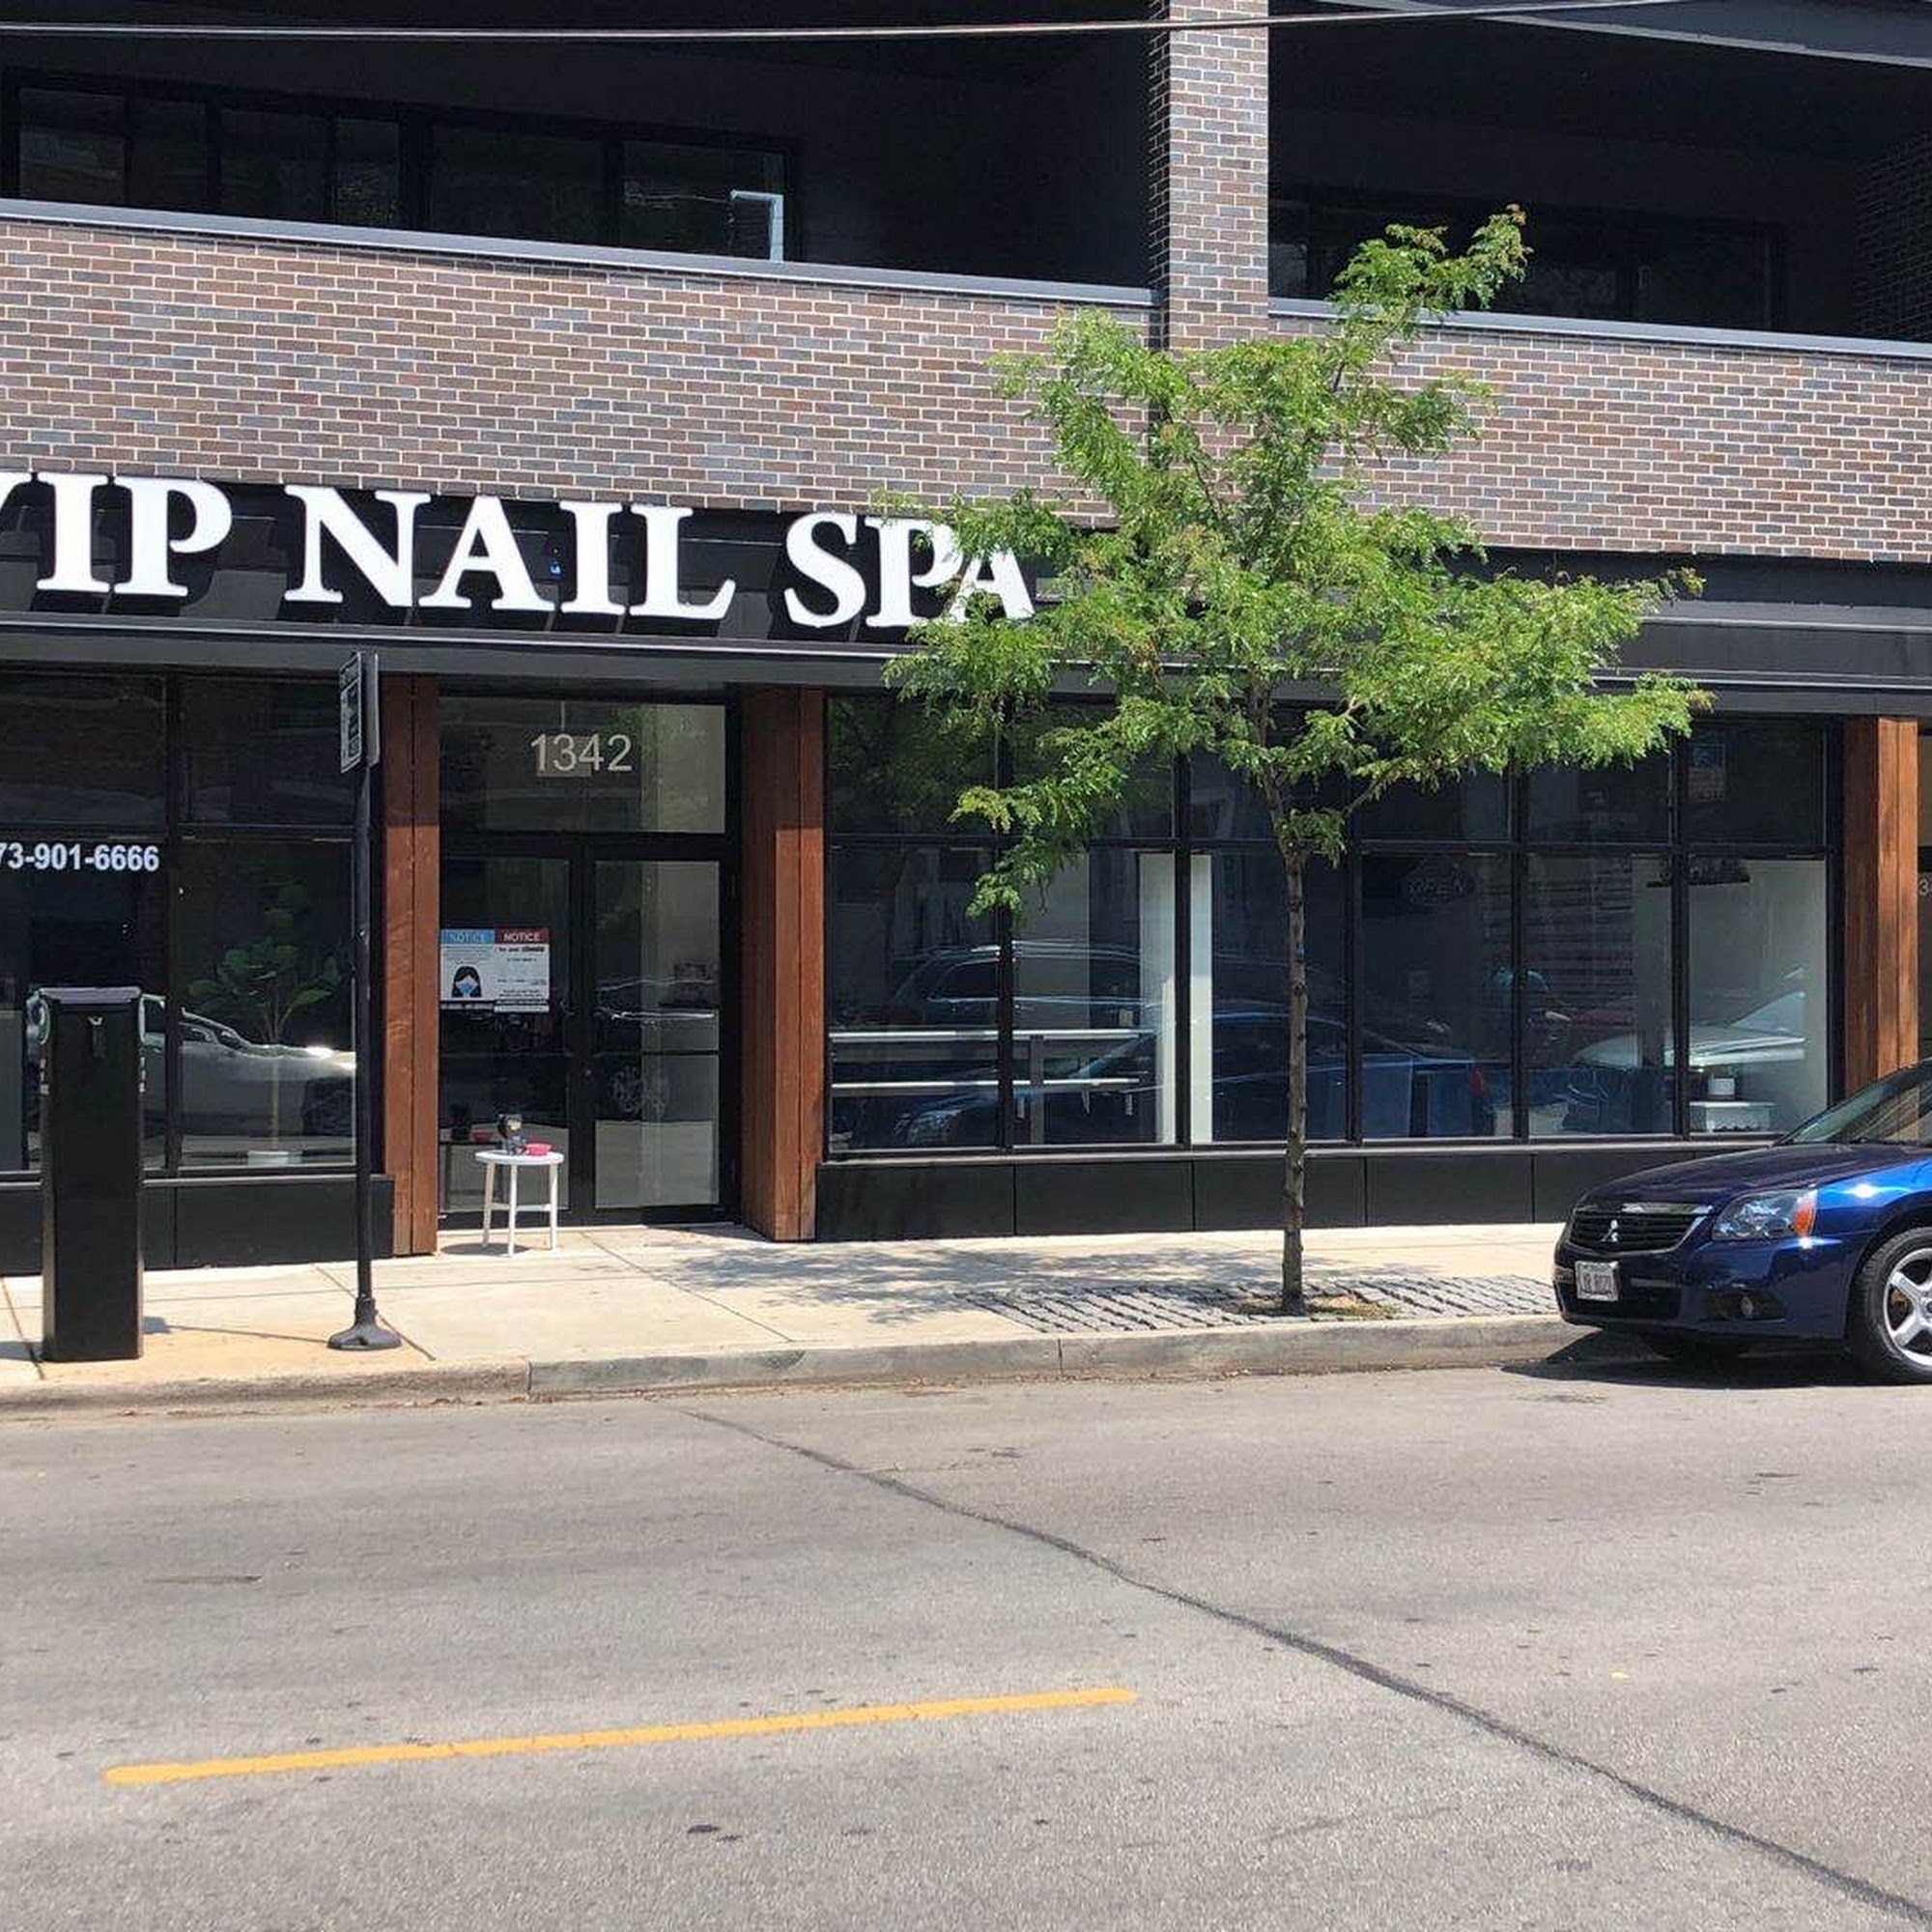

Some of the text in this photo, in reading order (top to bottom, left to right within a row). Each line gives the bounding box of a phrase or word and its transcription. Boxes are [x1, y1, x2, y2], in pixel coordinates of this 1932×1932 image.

[285, 484, 736, 619] NAIL
[784, 511, 1036, 628] SPA
[530, 733, 633, 772] 1342
[449, 931, 487, 943] NOTICE
[503, 932, 541, 942] NOTICE
